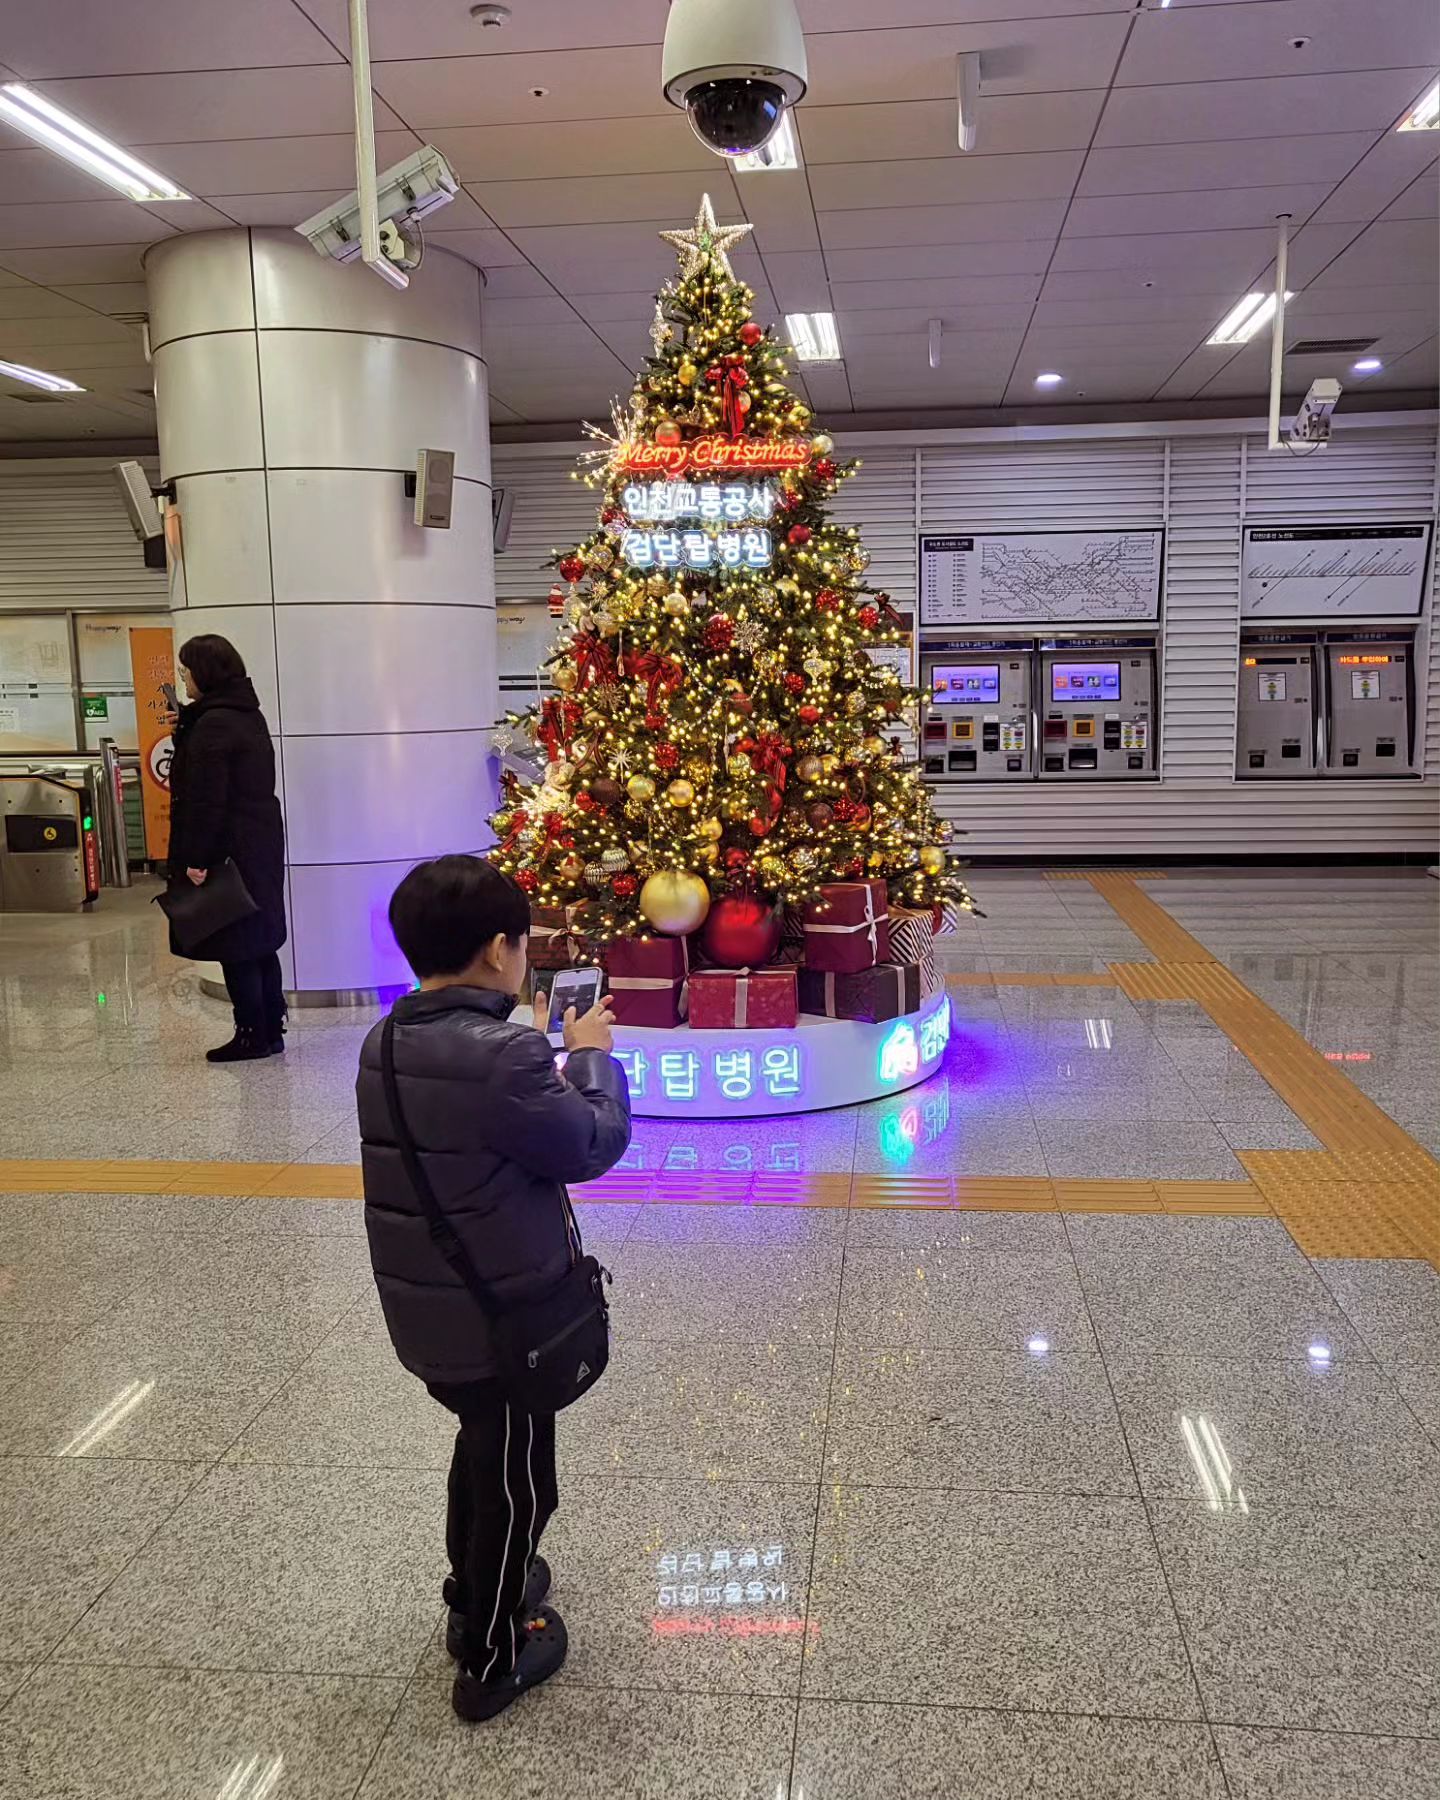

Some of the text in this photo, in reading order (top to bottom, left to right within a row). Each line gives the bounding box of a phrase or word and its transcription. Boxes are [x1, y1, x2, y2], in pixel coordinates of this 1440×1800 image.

[617, 438, 807, 468] Merry Christmas
[624, 486, 774, 518] 인천교통공사
[626, 532, 771, 563] 검단탑병원
